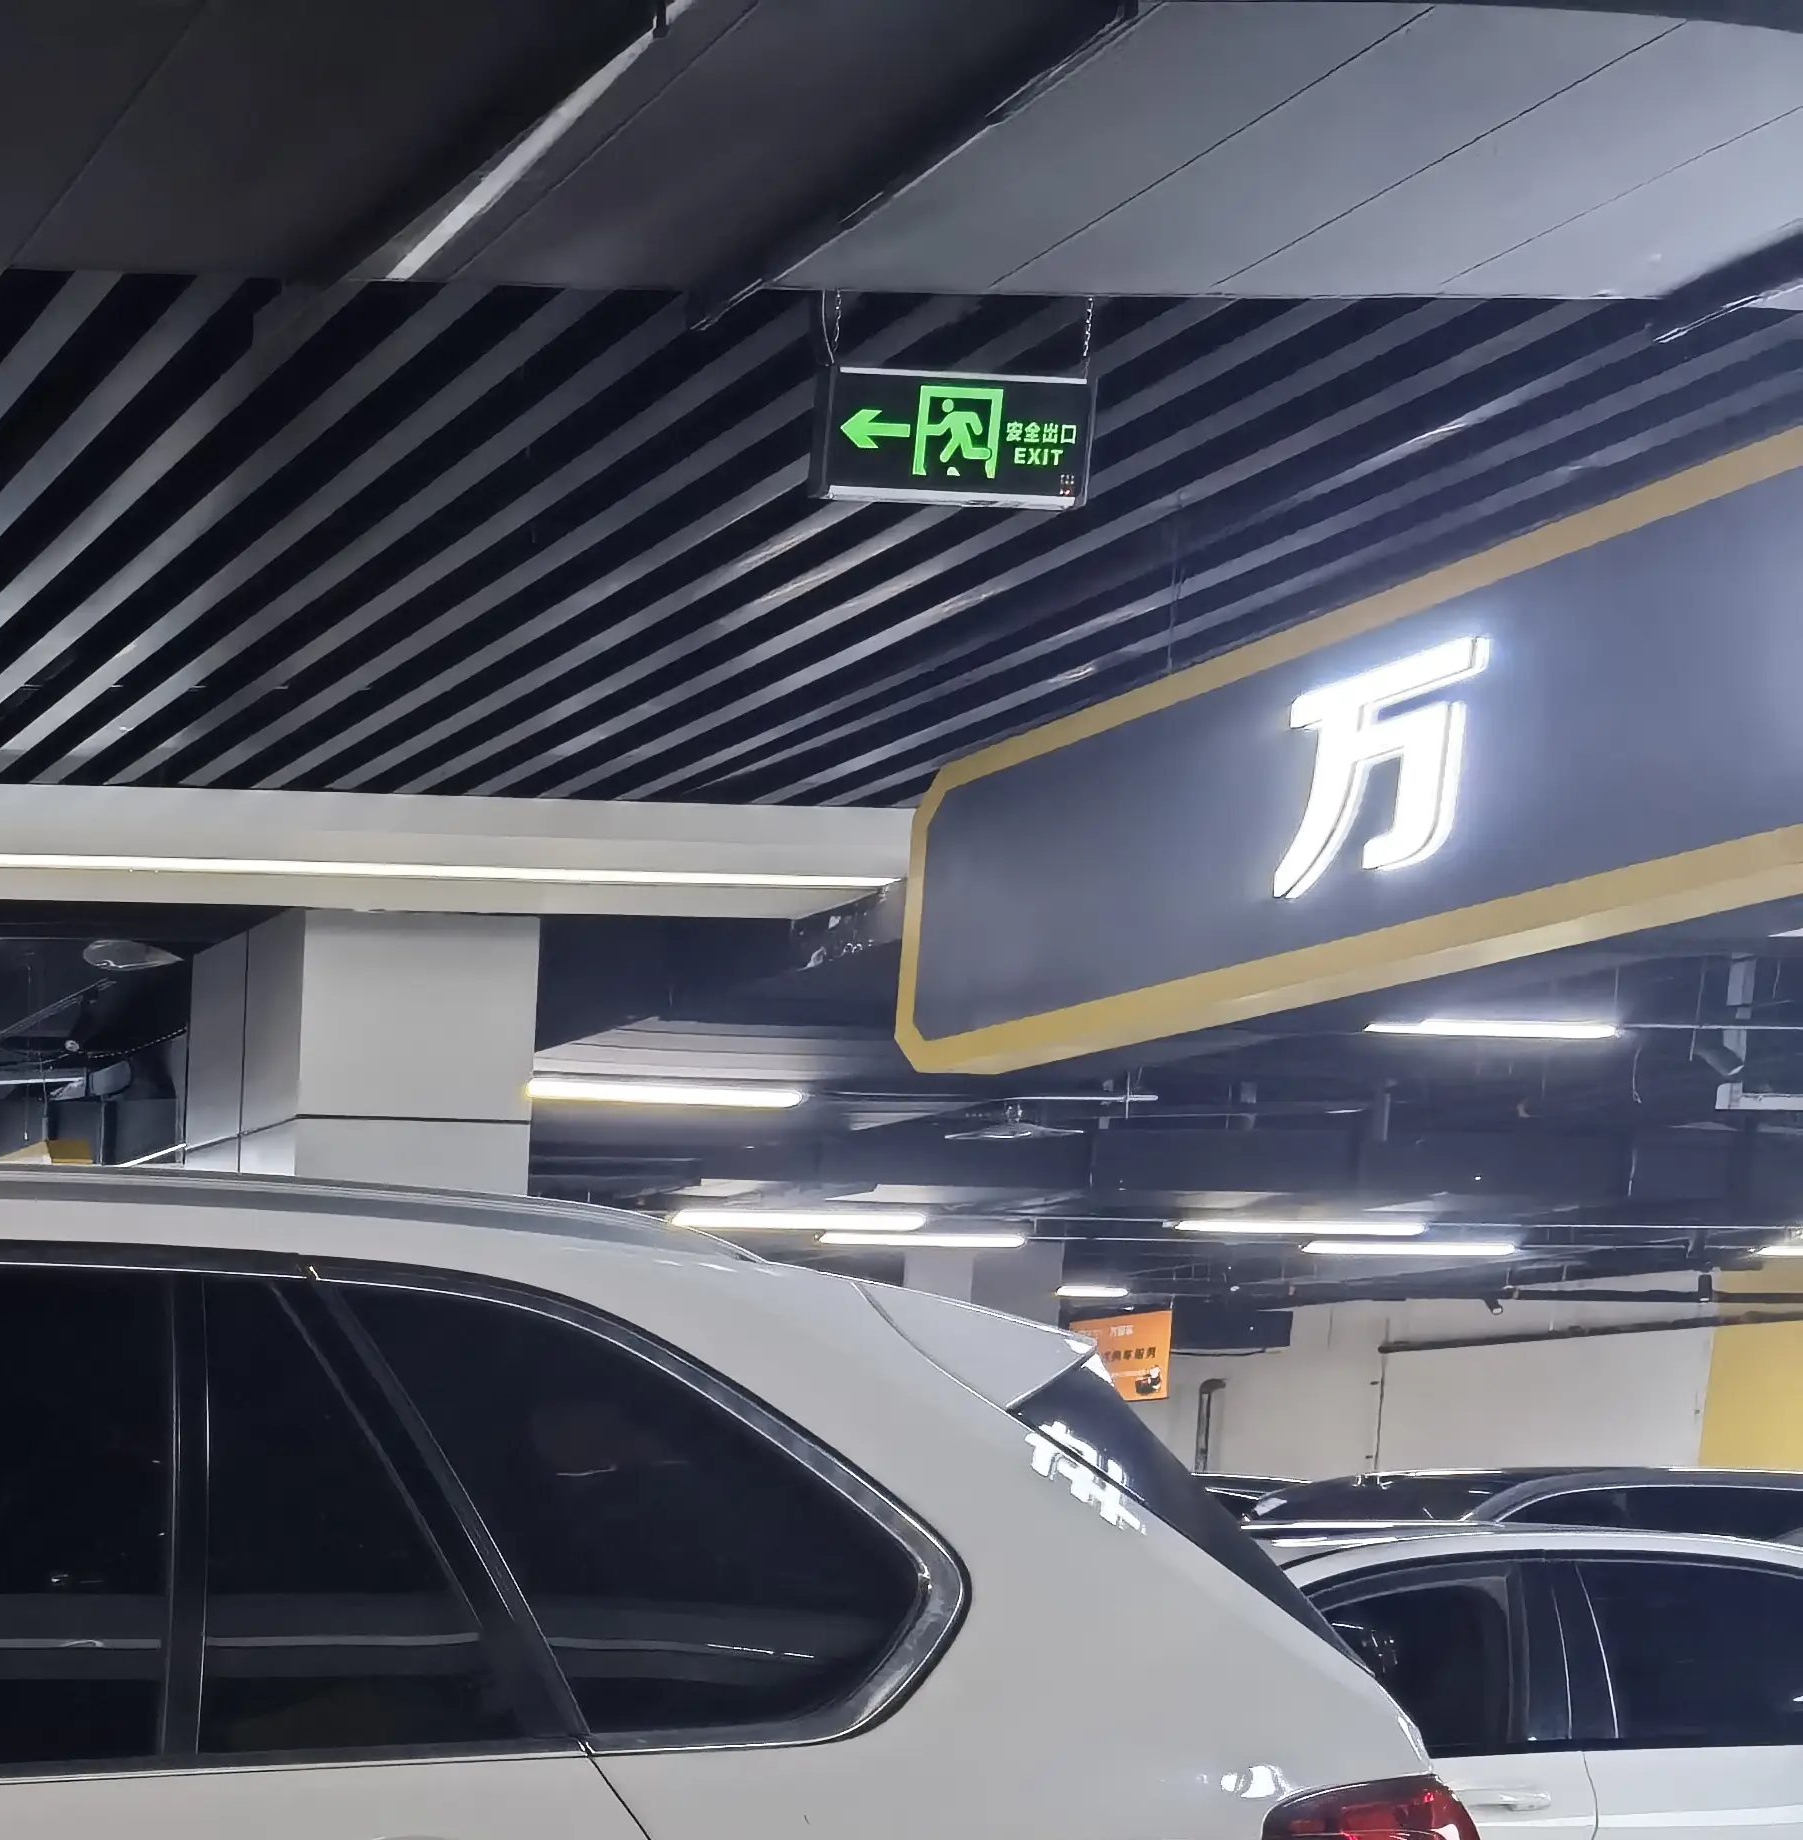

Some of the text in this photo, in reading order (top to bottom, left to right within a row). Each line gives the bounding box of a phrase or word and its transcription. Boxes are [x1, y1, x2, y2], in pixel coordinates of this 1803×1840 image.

[1005, 421, 1077, 445] 安全出口
[1013, 447, 1064, 466] EXIT
[1272, 635, 1489, 900] 万
